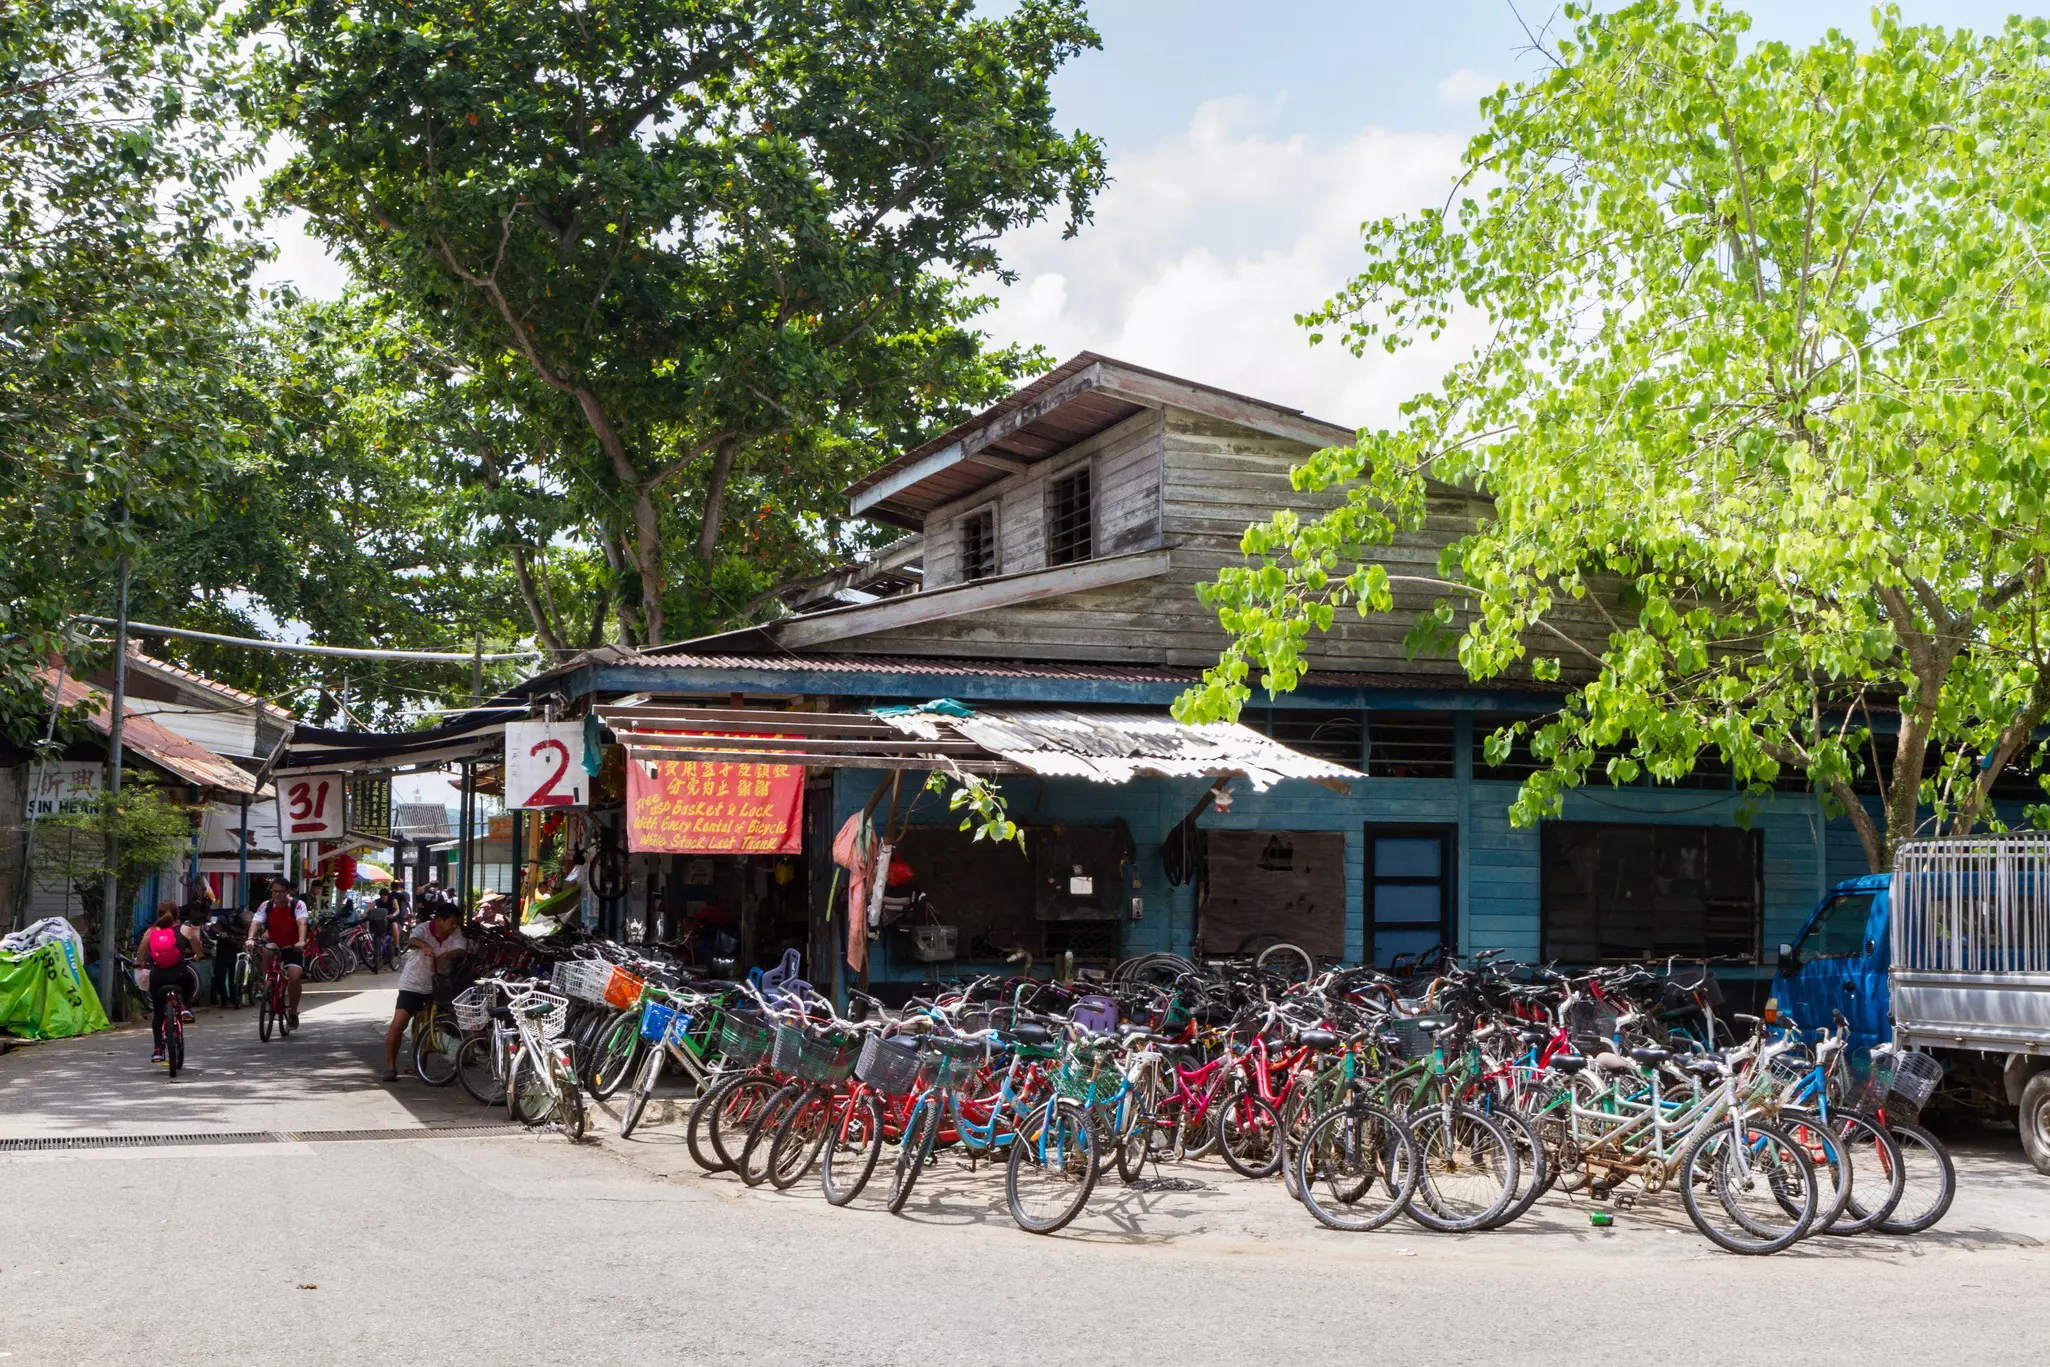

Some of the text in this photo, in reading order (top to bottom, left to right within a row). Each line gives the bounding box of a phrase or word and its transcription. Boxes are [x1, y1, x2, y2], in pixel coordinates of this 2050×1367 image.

[522, 739, 574, 807] 2
[28, 800, 52, 814] SIN
[288, 781, 329, 820] 31
[635, 793, 660, 813] Free
[672, 799, 724, 817] Basket
[739, 802, 775, 817] Lock
[634, 816, 787, 836] With Every Rental of Bicycle
[640, 833, 778, 849] While Stock Last Thank
